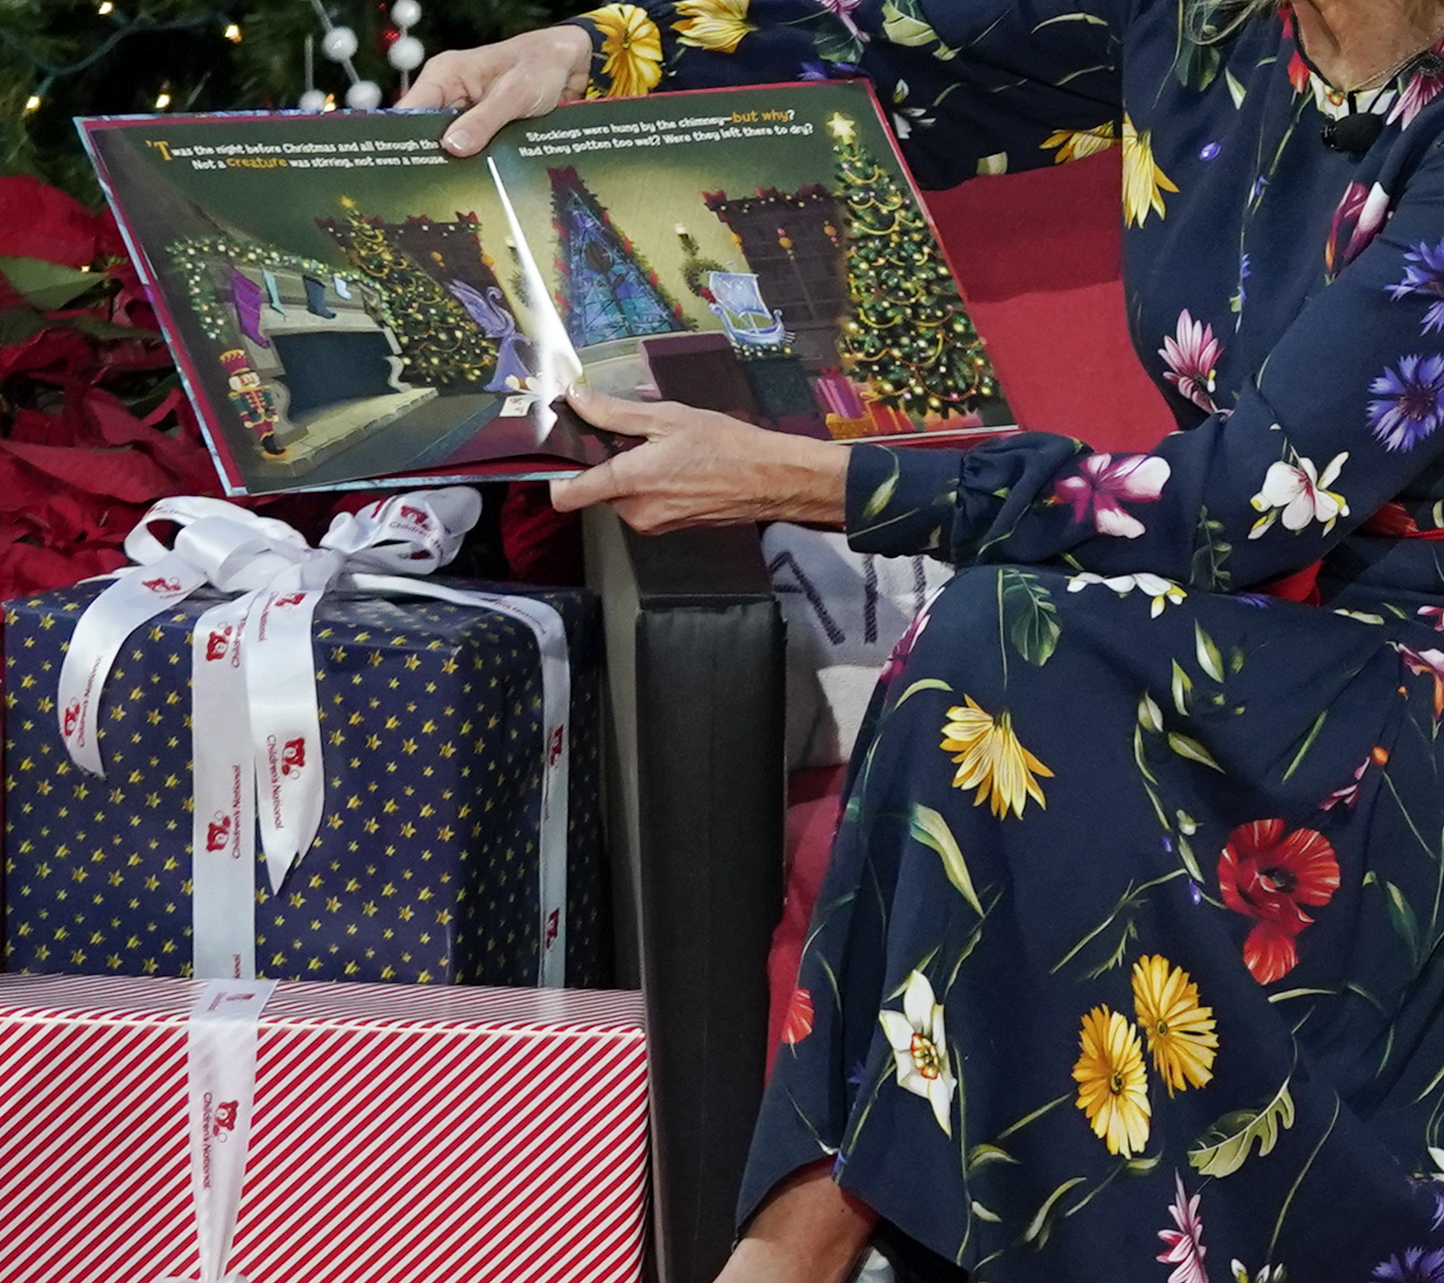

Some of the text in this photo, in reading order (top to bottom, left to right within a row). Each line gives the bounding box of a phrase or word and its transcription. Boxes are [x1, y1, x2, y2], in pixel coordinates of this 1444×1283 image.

[525, 128, 582, 143] Stockings
[583, 123, 610, 135] were
[611, 120, 640, 135] hung
[640, 120, 655, 133] by
[656, 118, 677, 131] the
[762, 109, 795, 124] why?
[195, 145, 214, 156] the
[215, 143, 244, 157] night
[245, 142, 281, 156] before
[282, 141, 336, 154] Christmas
[338, 141, 359, 153] and
[359, 139, 374, 151] all
[375, 139, 419, 153] through
[420, 139, 439, 150] the
[518, 122, 814, 158] Had they gotten too wet? Were they left there to dry?
[192, 159, 216, 170] Not
[226, 157, 287, 169] creature
[288, 158, 310, 168] was
[353, 156, 374, 167] not
[375, 157, 401, 166] even
